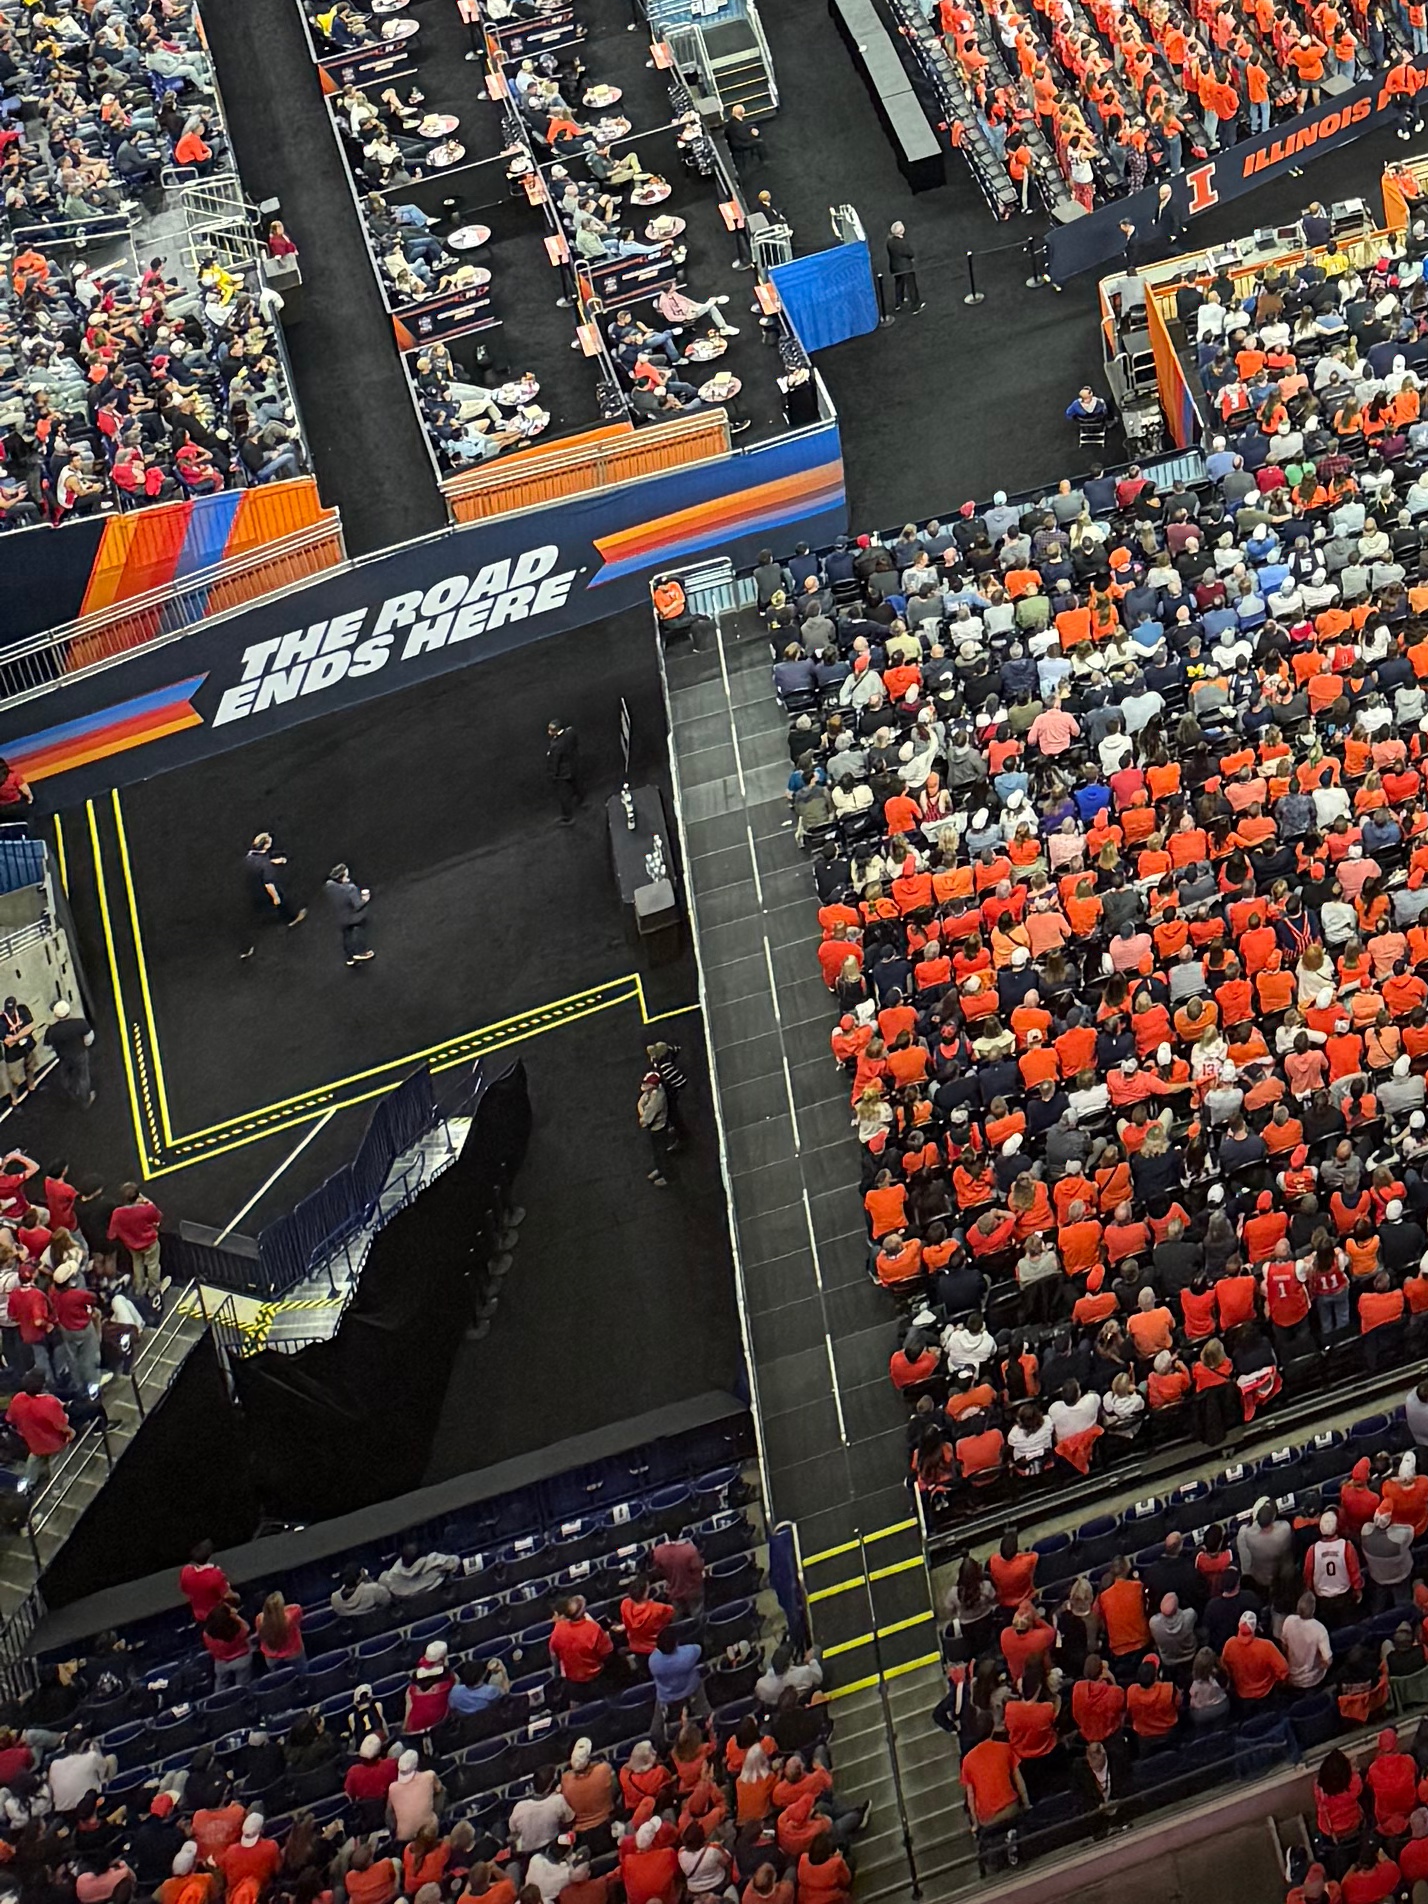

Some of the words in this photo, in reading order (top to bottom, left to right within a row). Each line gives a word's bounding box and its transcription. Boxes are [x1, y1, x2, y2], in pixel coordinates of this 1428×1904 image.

[1242, 95, 1372, 179] ILLINOIS
[211, 632, 396, 729] ENDS
[399, 568, 578, 662] HERE
[240, 606, 368, 683] THE
[371, 544, 560, 636] ROAD
